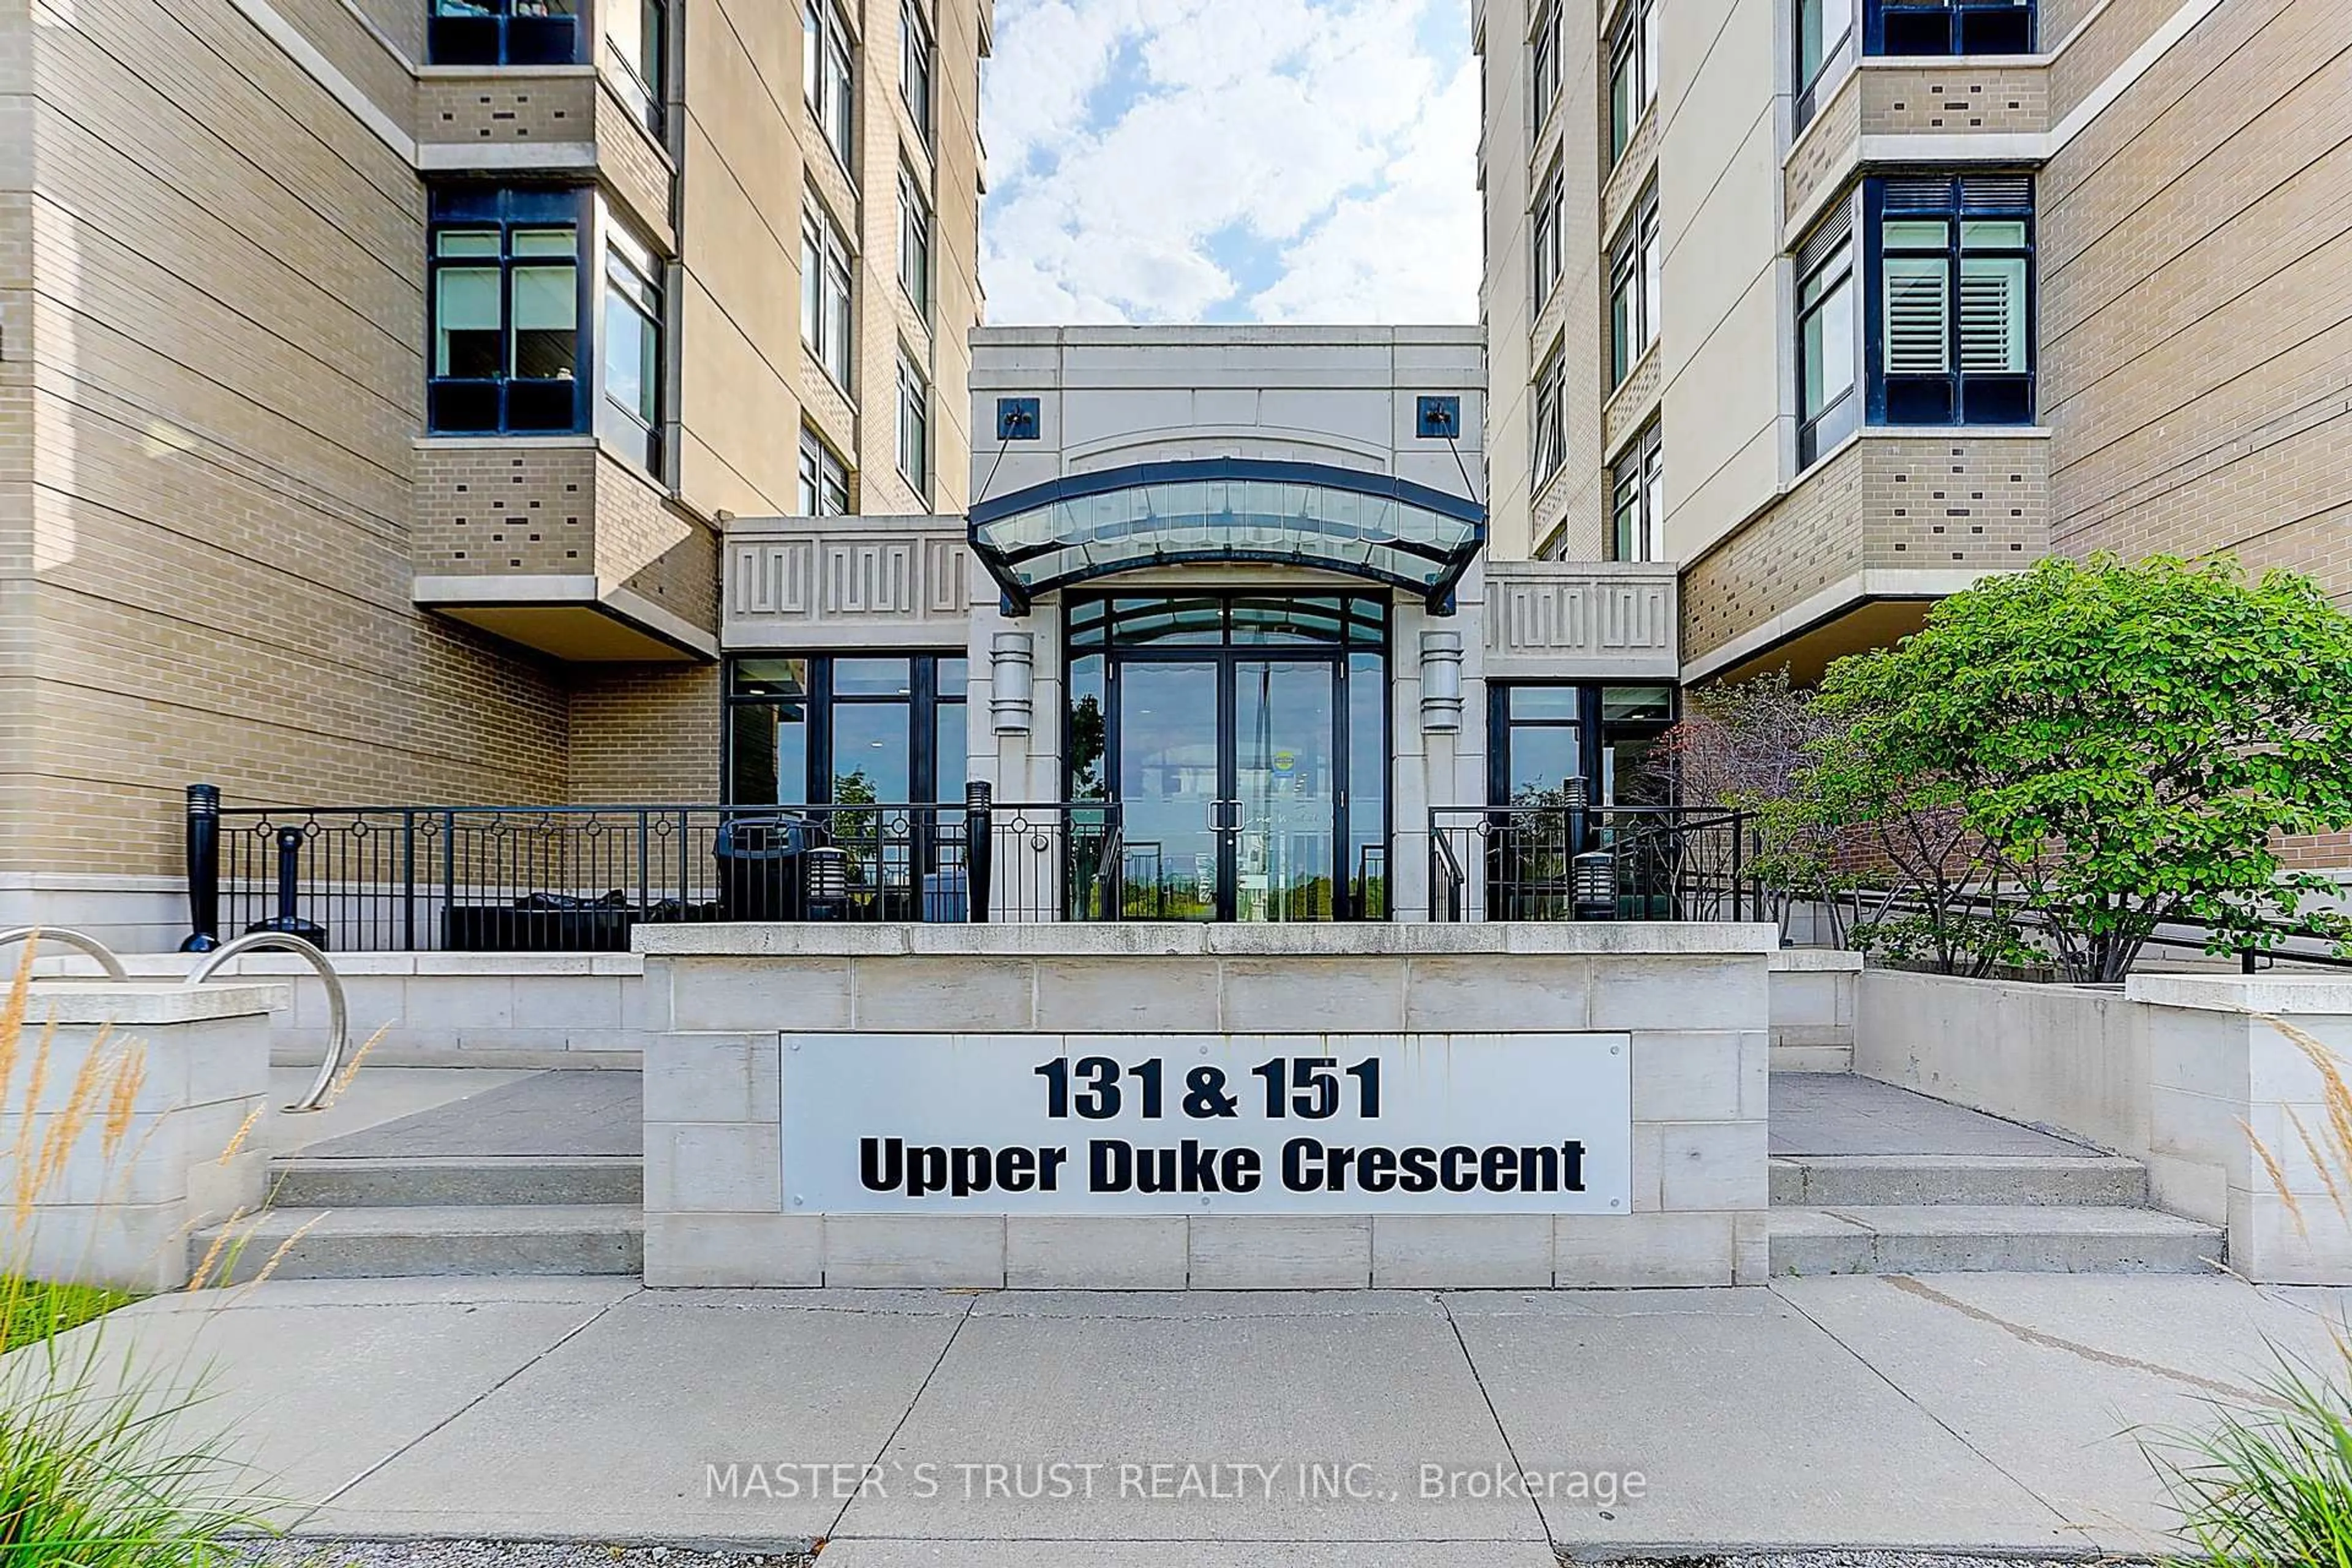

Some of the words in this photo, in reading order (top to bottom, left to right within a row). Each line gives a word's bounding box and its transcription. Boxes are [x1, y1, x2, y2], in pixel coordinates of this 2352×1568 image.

[1035, 1057, 1162, 1119] 131
[1182, 1066, 1238, 1118] &
[1251, 1057, 1379, 1119] 151
[860, 1137, 1066, 1197] Upper
[1089, 1139, 1261, 1193] Duke
[1281, 1137, 1586, 1193] Crescent
